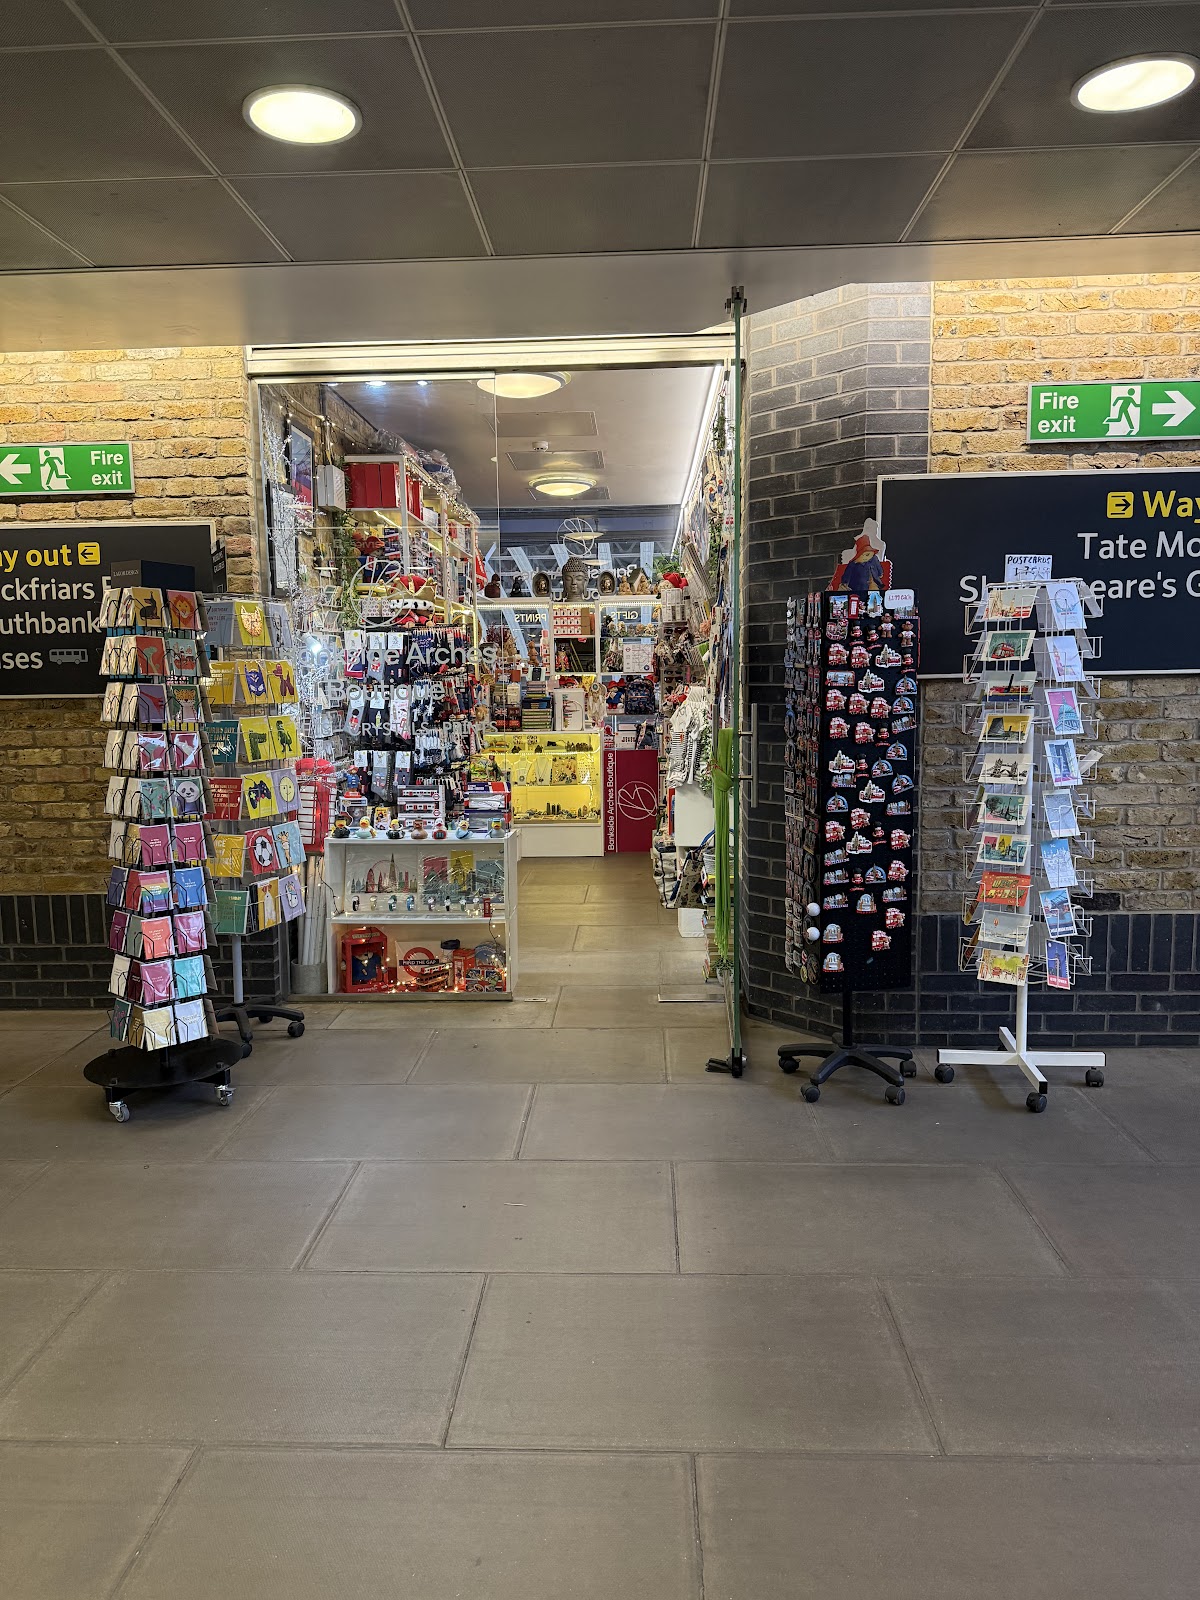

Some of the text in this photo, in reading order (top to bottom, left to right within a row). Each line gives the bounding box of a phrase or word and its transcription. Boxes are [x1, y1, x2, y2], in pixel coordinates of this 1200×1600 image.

[1038, 391, 1080, 410] Fire
[1037, 414, 1076, 434] exit
[90, 450, 124, 466] Fire
[91, 469, 123, 486] exit
[25, 544, 73, 566] out
[1077, 530, 1200, 560] Tate Mo
[1007, 555, 1051, 565] POSTCARDS
[406, 640, 497, 665] Arches
[326, 678, 446, 704] Boutique
[353, 721, 429, 737] CRYSTALS
[443, 720, 498, 736] PRINTS
[606, 752, 616, 851] Bankside Arches Boutique
